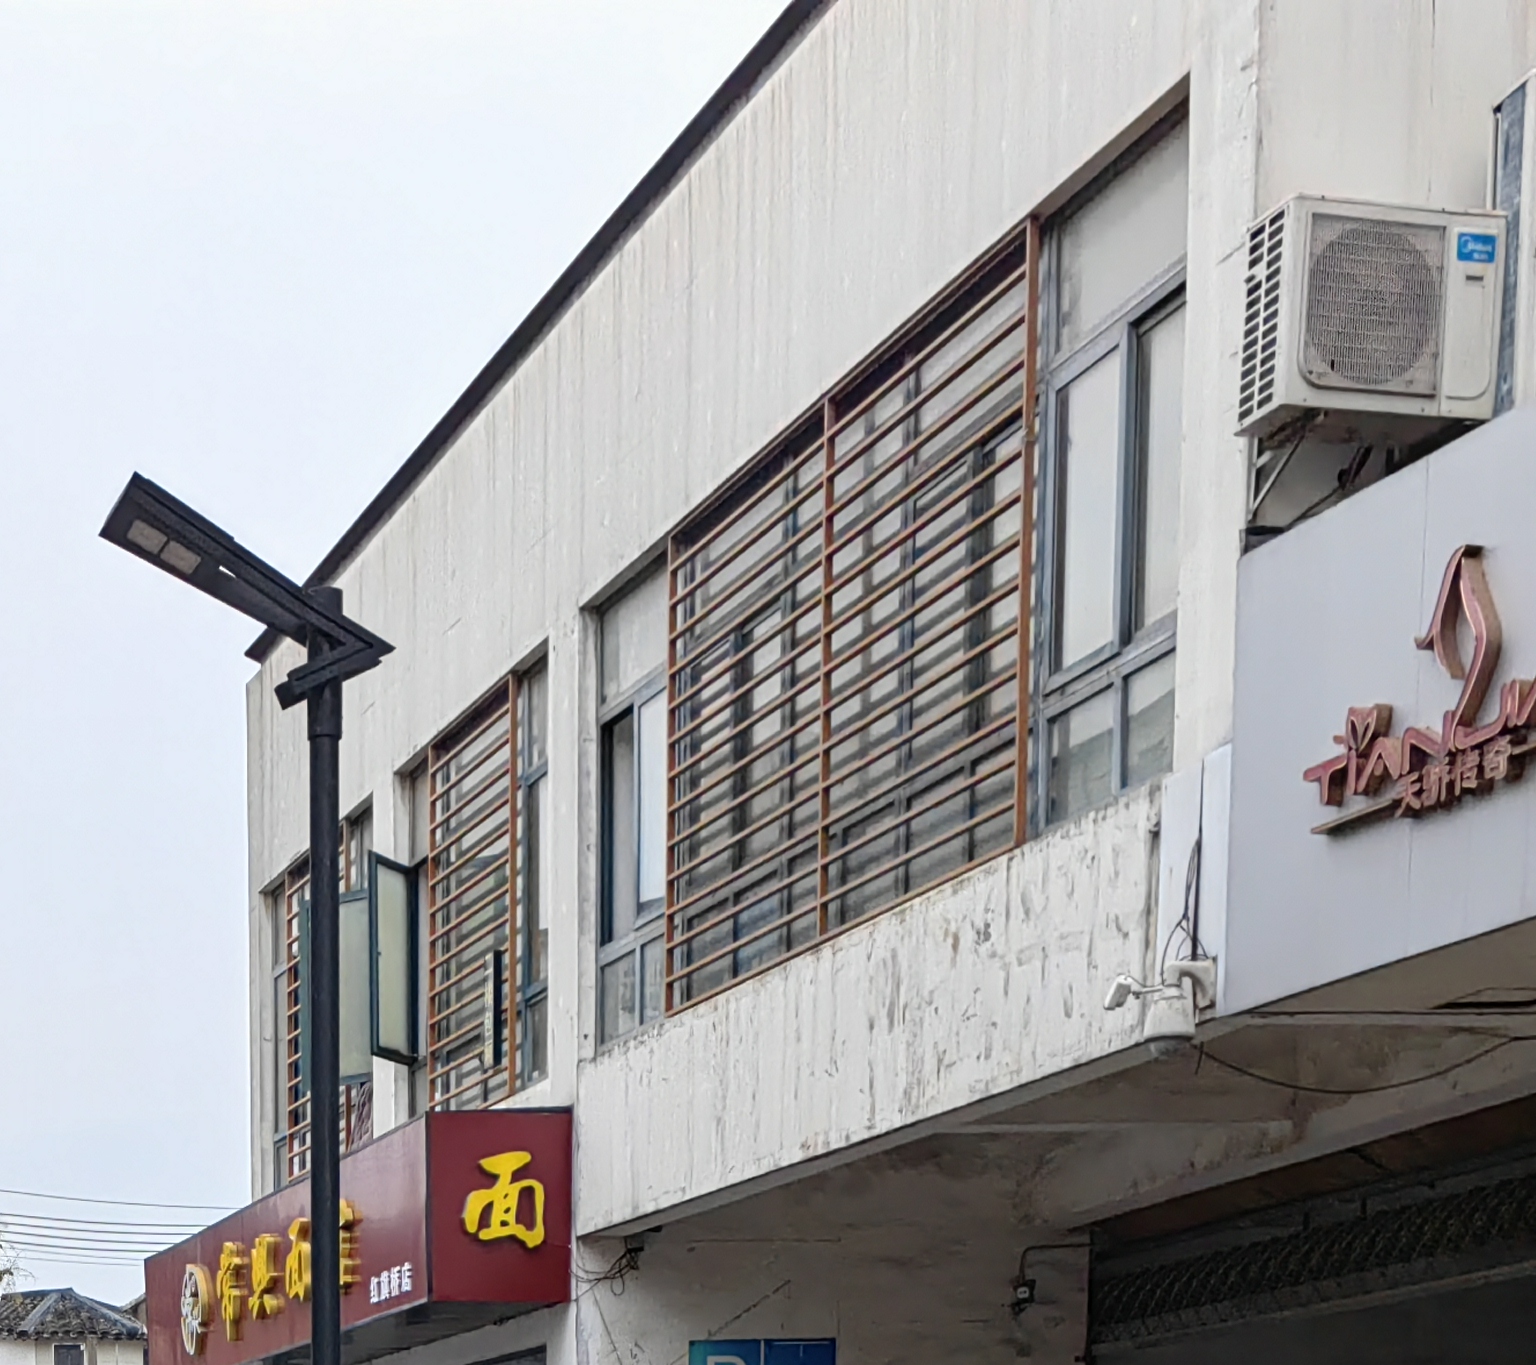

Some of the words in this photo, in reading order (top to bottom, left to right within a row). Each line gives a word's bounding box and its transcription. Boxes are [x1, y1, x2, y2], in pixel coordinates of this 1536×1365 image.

[1393, 735, 1512, 818] 天骄传奇
[463, 1150, 545, 1249] 面
[370, 1262, 412, 1304] 红旗桥店
